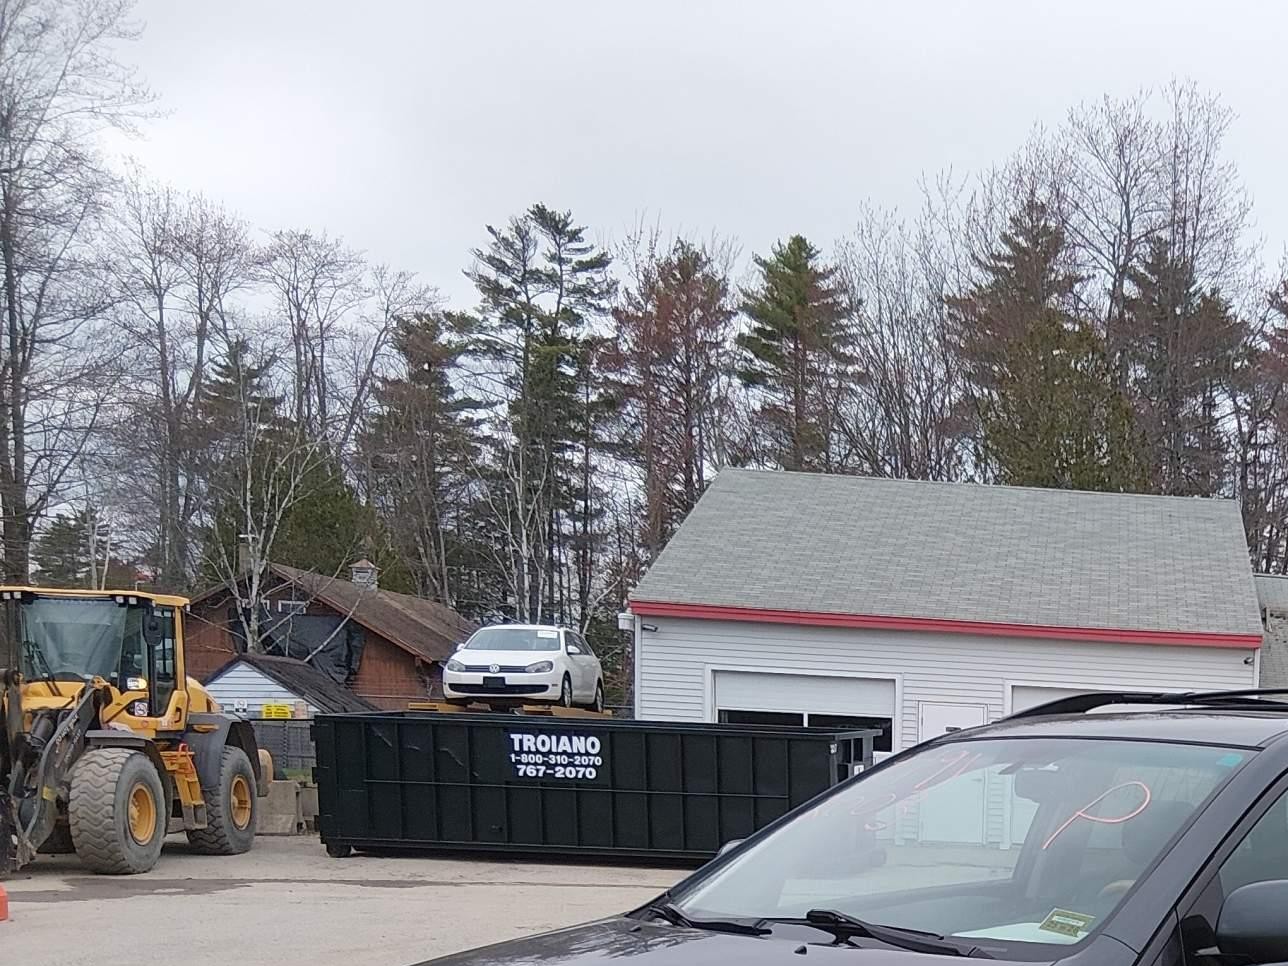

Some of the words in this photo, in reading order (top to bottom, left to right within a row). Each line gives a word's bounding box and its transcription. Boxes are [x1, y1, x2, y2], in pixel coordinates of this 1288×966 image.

[510, 734, 601, 754] TROIANO
[510, 753, 603, 766] 1-800-310-2070
[516, 765, 597, 779] 767-2070
